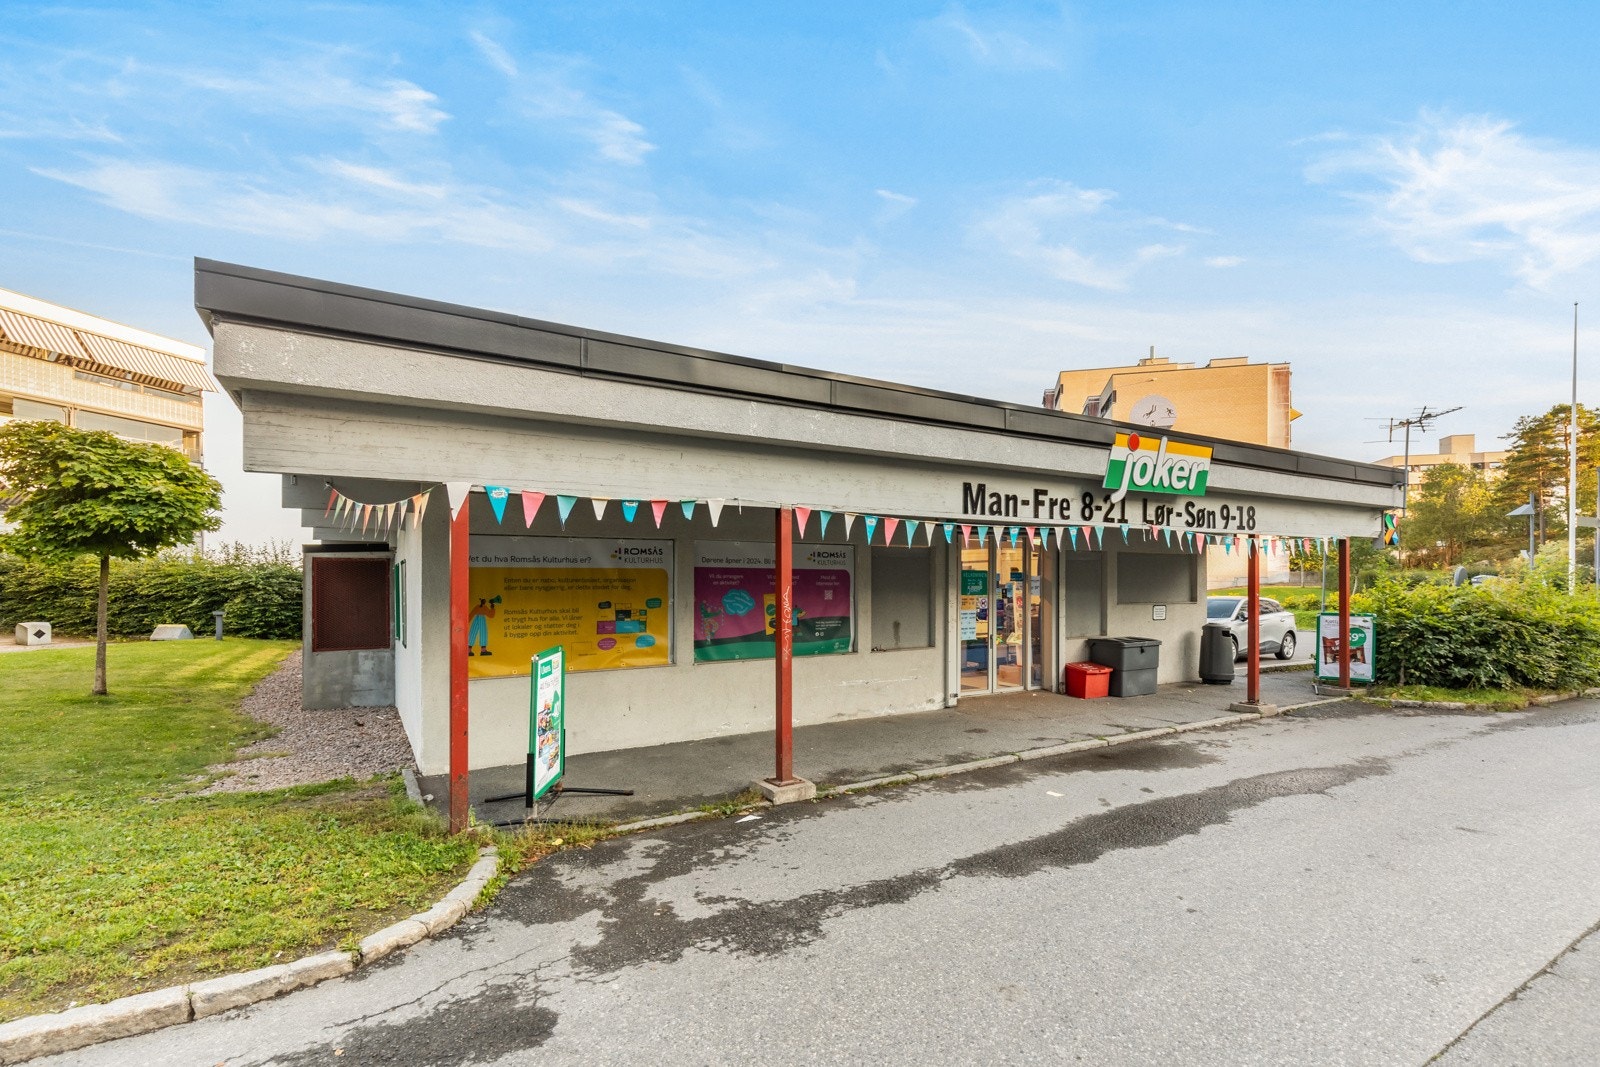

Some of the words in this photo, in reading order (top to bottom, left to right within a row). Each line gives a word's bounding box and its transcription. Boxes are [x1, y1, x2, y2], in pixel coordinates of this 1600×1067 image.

[1110, 432, 1206, 503] joker
[962, 482, 1071, 520] Man-Fre
[1081, 491, 1128, 524] 8-21
[1142, 498, 1217, 530] Lør-Søn
[1220, 504, 1257, 531] 9-18
[624, 546, 663, 555] ROMSÅS
[481, 555, 492, 563] du
[494, 555, 508, 563] hva
[510, 555, 541, 563] Romsås
[542, 556, 578, 564] Kulturhus
[701, 556, 724, 564] Dørene
[725, 556, 742, 566] åpner
[504, 607, 528, 615] Romsås
[529, 607, 558, 615] Kulturhus
[565, 622, 577, 630] deg
[509, 631, 528, 639] bygge
[529, 630, 542, 638] opp
